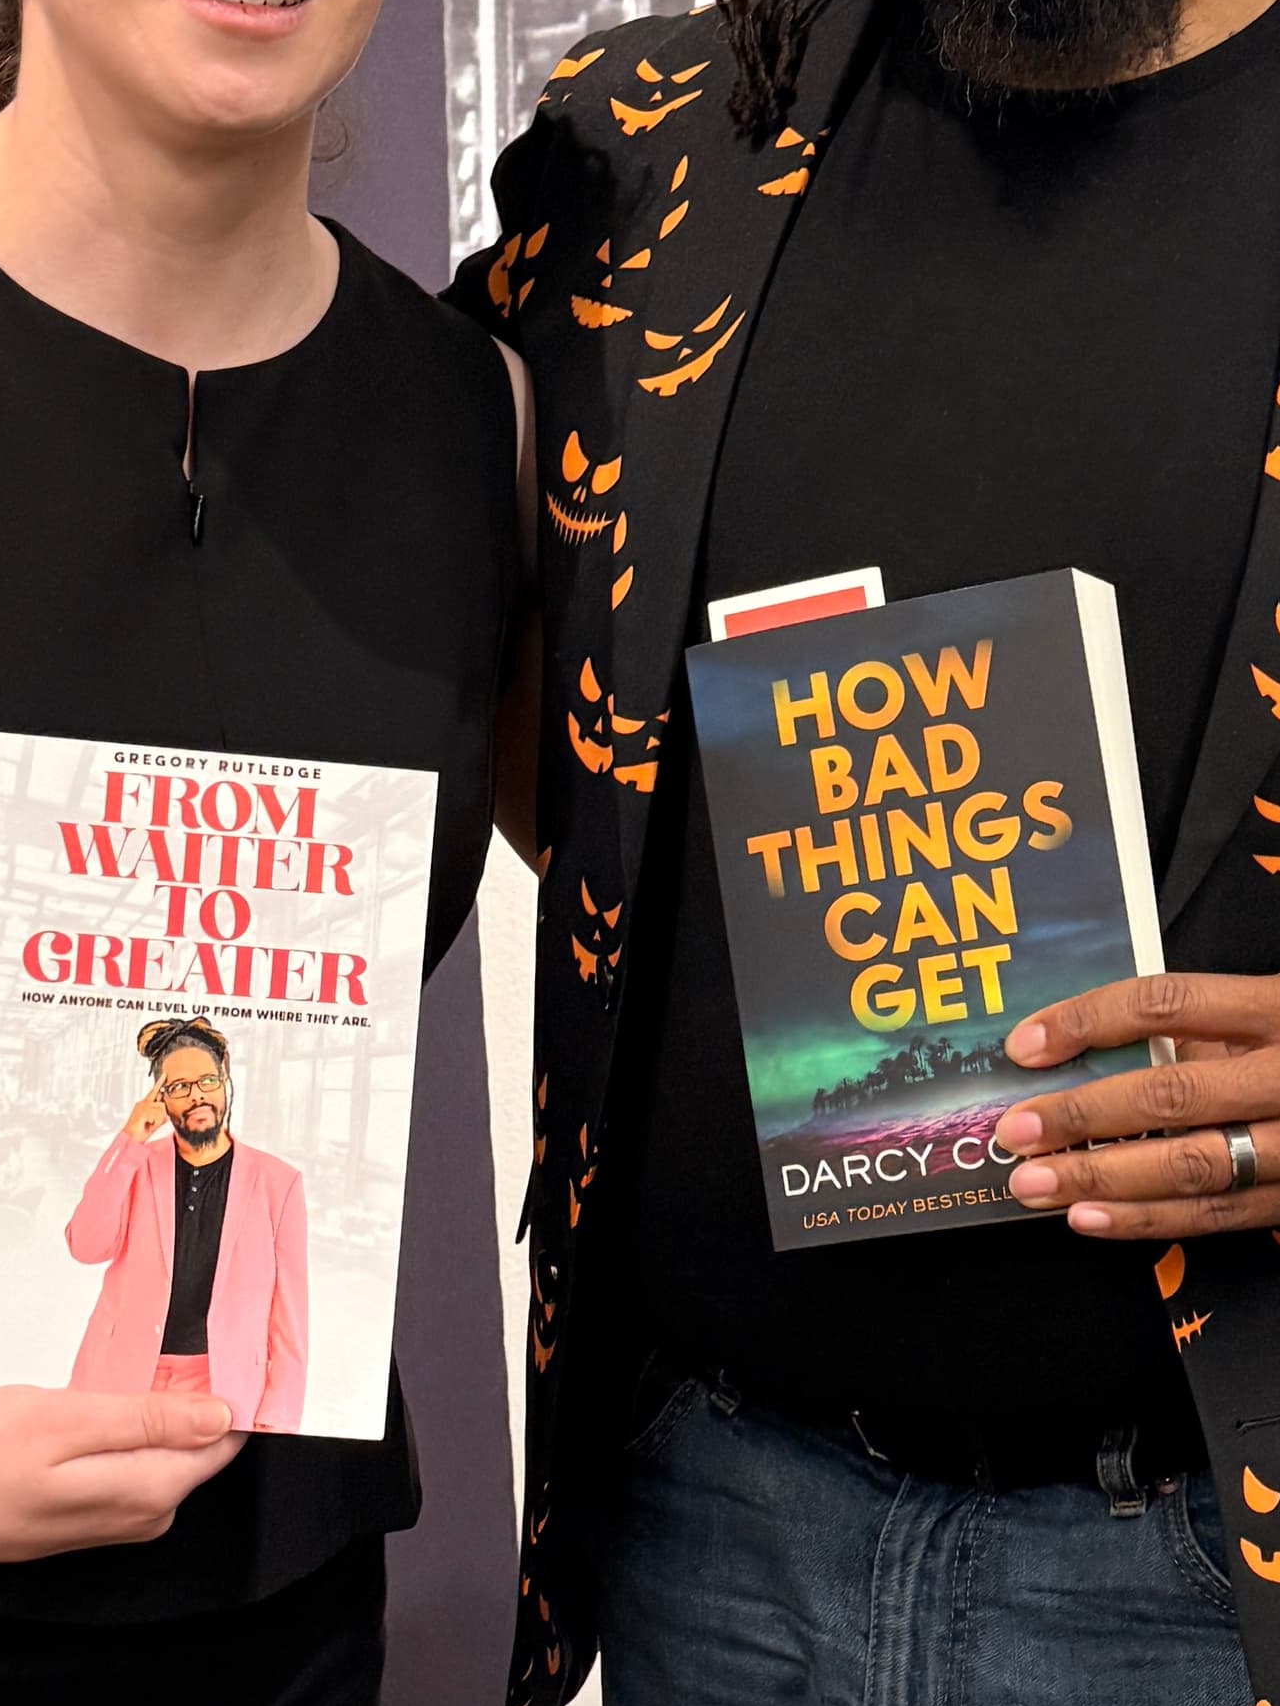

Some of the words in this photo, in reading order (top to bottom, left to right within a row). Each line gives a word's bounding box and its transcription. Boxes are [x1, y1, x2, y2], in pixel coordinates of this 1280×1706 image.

[772, 639, 993, 747] HOW
[114, 751, 208, 770] GREGORY
[218, 760, 323, 780] RUTLEDGE
[810, 723, 980, 815] BAD
[102, 771, 319, 839] FROM
[746, 780, 1073, 899] THINGS
[56, 821, 356, 896] WAITER
[153, 884, 252, 941] TO
[824, 867, 1018, 962] CAN
[21, 930, 369, 1006] GREATER
[849, 944, 1012, 1033] GET
[22, 992, 55, 1004] HOW
[59, 995, 113, 1009] ANYONE
[116, 999, 145, 1011] CAN
[148, 1001, 188, 1014] LEVEL
[192, 1004, 210, 1016] UP
[214, 1007, 252, 1019] FROM
[256, 1009, 303, 1023] WHERE
[306, 1013, 339, 1025] THEY
[342, 1016, 372, 1028] ARE.
[780, 1143, 934, 1197] DARCY
[803, 1212, 841, 1229] USA
[847, 1201, 908, 1223] TODAY
[913, 1186, 1013, 1214] BESTSELL
